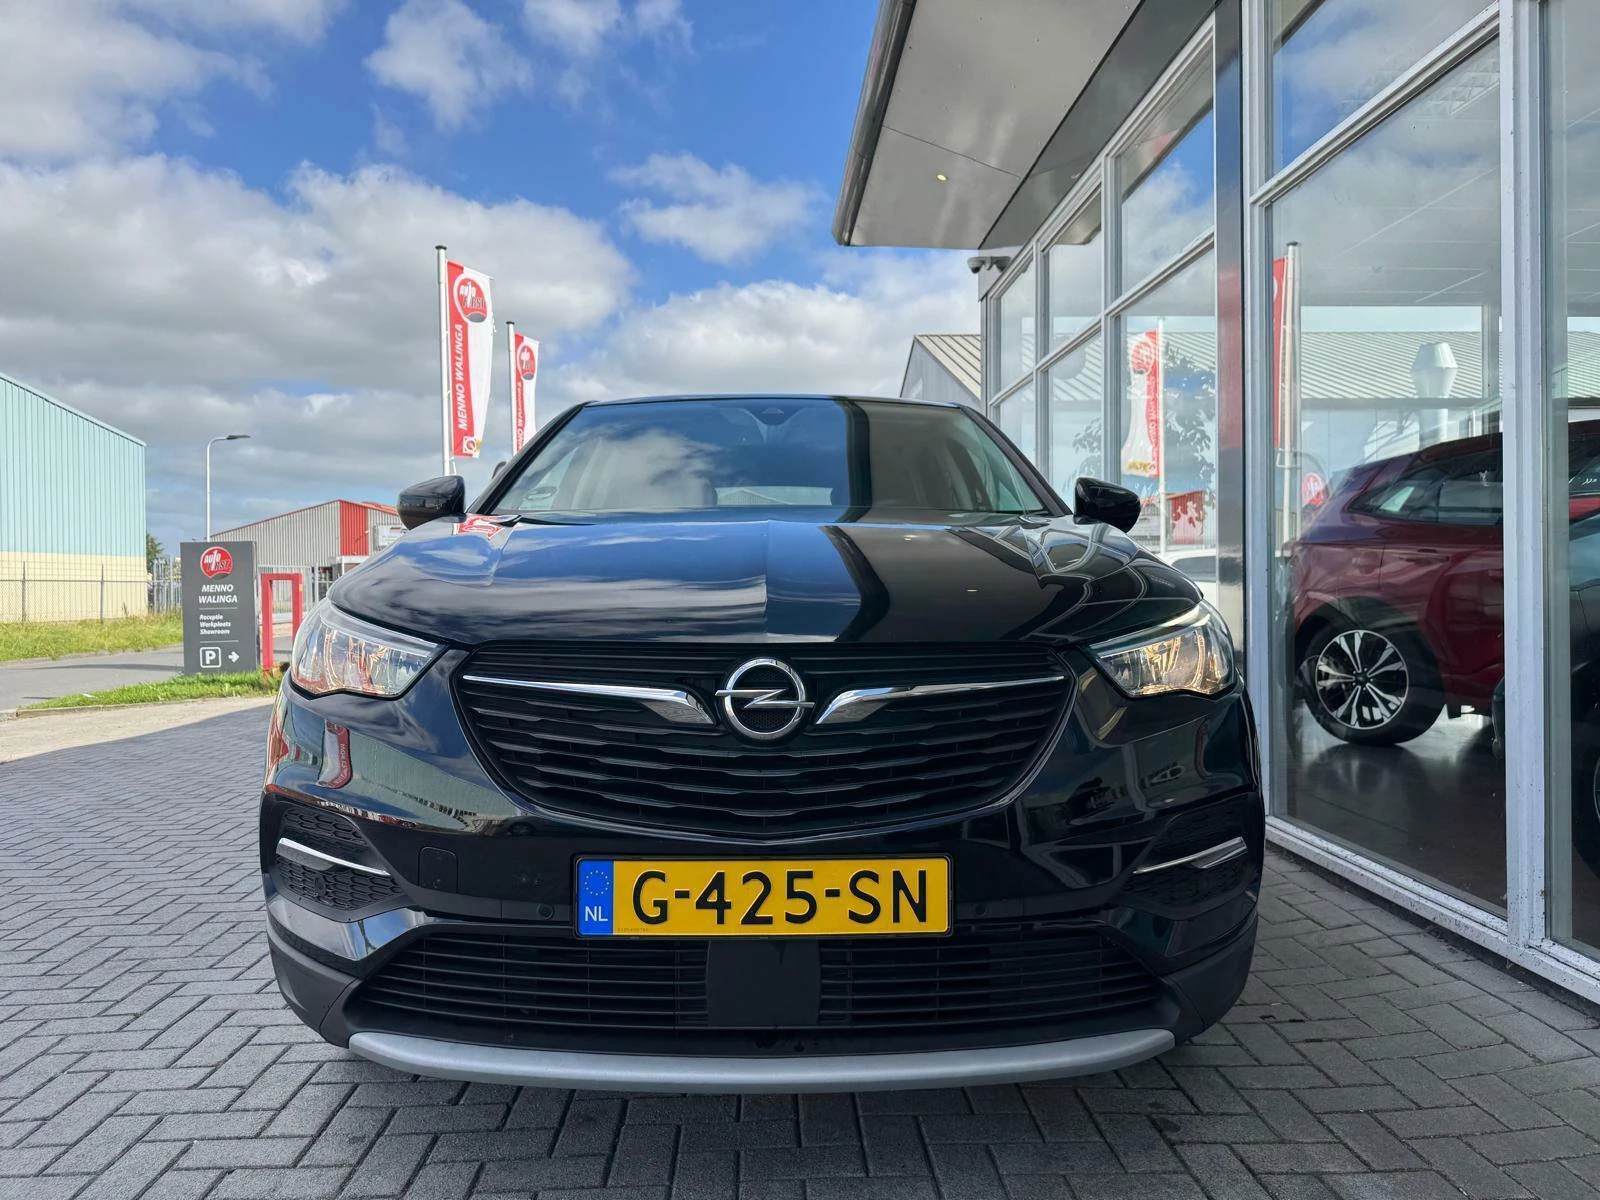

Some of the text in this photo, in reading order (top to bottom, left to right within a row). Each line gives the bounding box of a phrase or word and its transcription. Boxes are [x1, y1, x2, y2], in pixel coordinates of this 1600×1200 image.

[454, 323, 468, 430] MENNO WALINGA
[201, 584, 234, 593] MENNO
[198, 595, 238, 604] WALINGA
[205, 650, 216, 664] P
[632, 870, 927, 925] G-425-SN
[584, 906, 608, 922] NL
